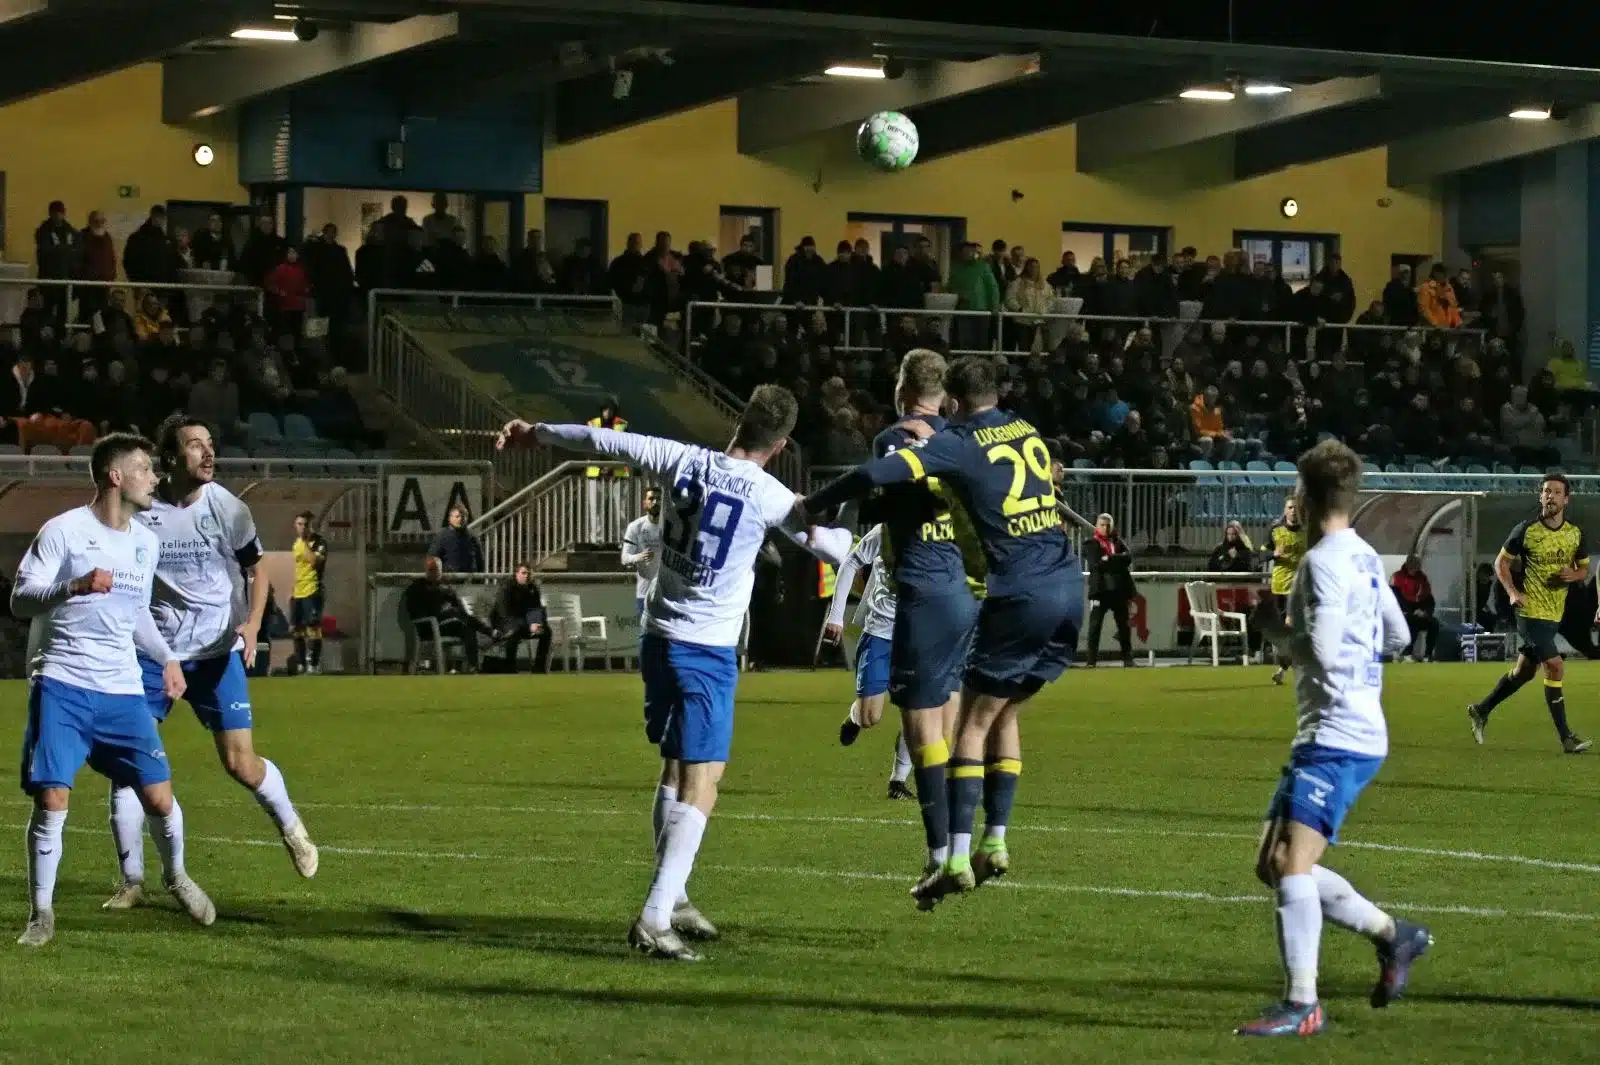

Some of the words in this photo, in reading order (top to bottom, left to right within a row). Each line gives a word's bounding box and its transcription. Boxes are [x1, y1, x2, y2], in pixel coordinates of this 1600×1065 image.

[987, 437, 1056, 518] 29
[159, 539, 209, 549] telierho
[112, 582, 143, 594] sensee
